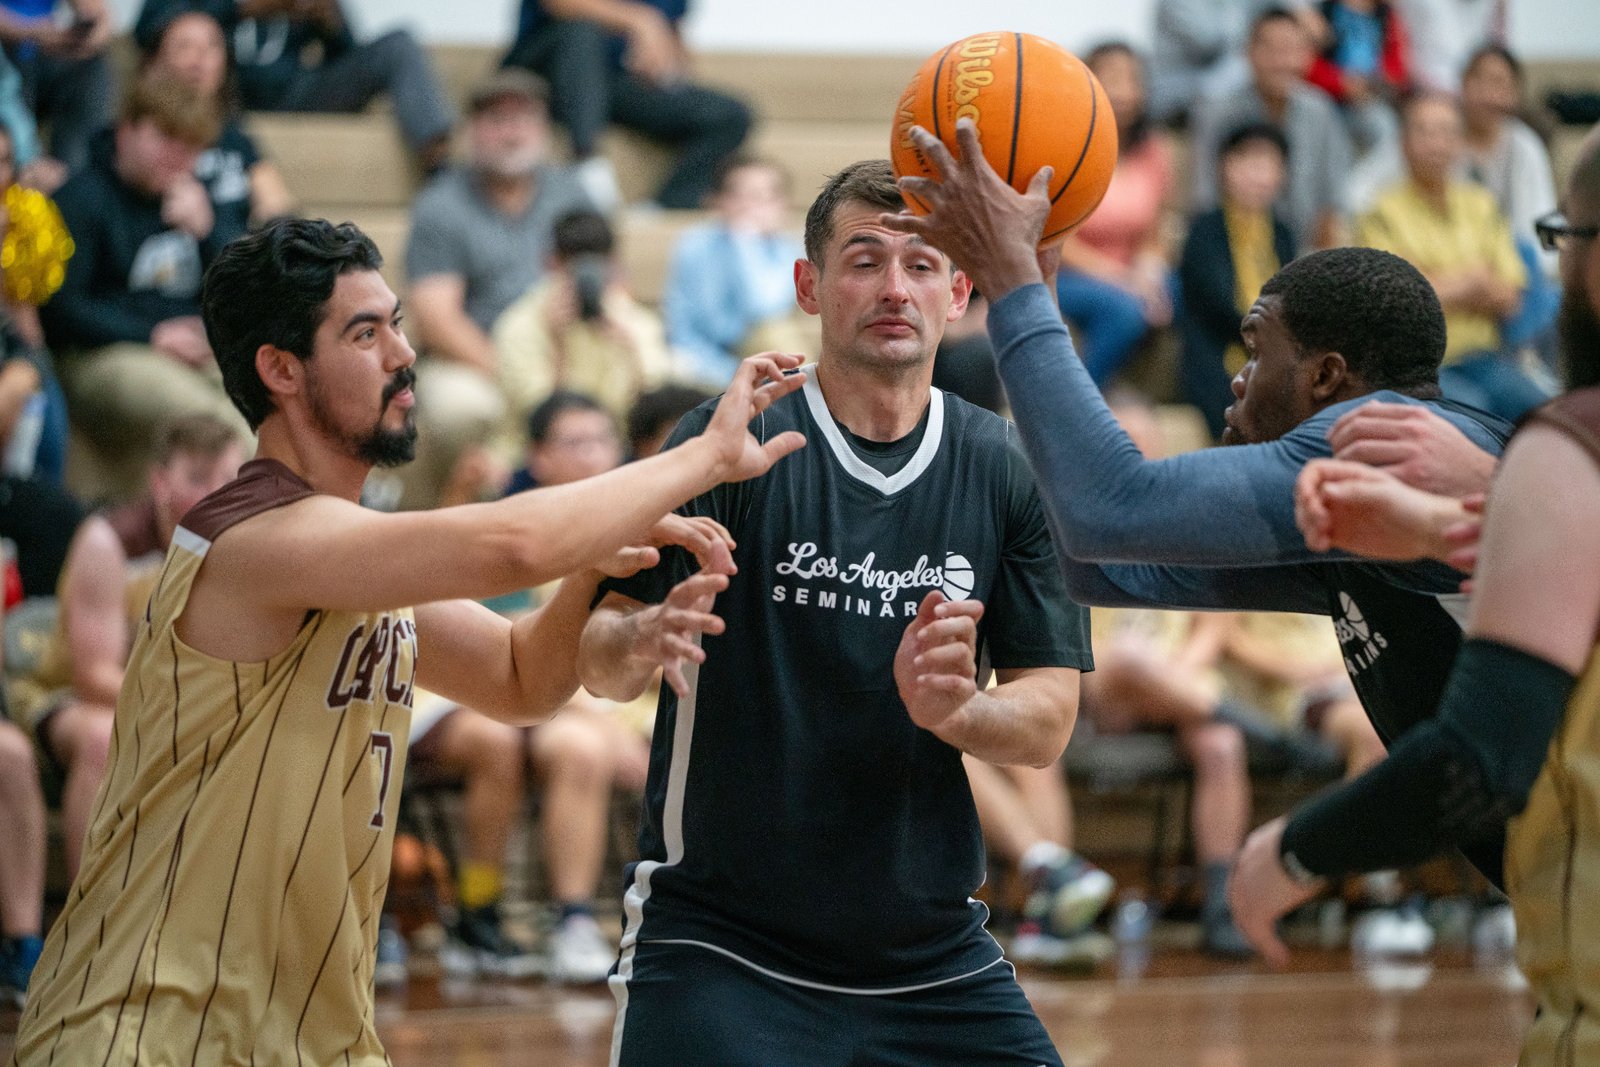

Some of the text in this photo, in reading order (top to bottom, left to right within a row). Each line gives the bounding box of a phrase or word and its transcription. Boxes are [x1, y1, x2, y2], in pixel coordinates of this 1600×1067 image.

[954, 34, 1001, 140] Wilso
[772, 585, 918, 618] SEMINAR
[775, 542, 945, 602] Los Angeles
[327, 615, 417, 709] CAPC
[370, 731, 393, 820] 7
